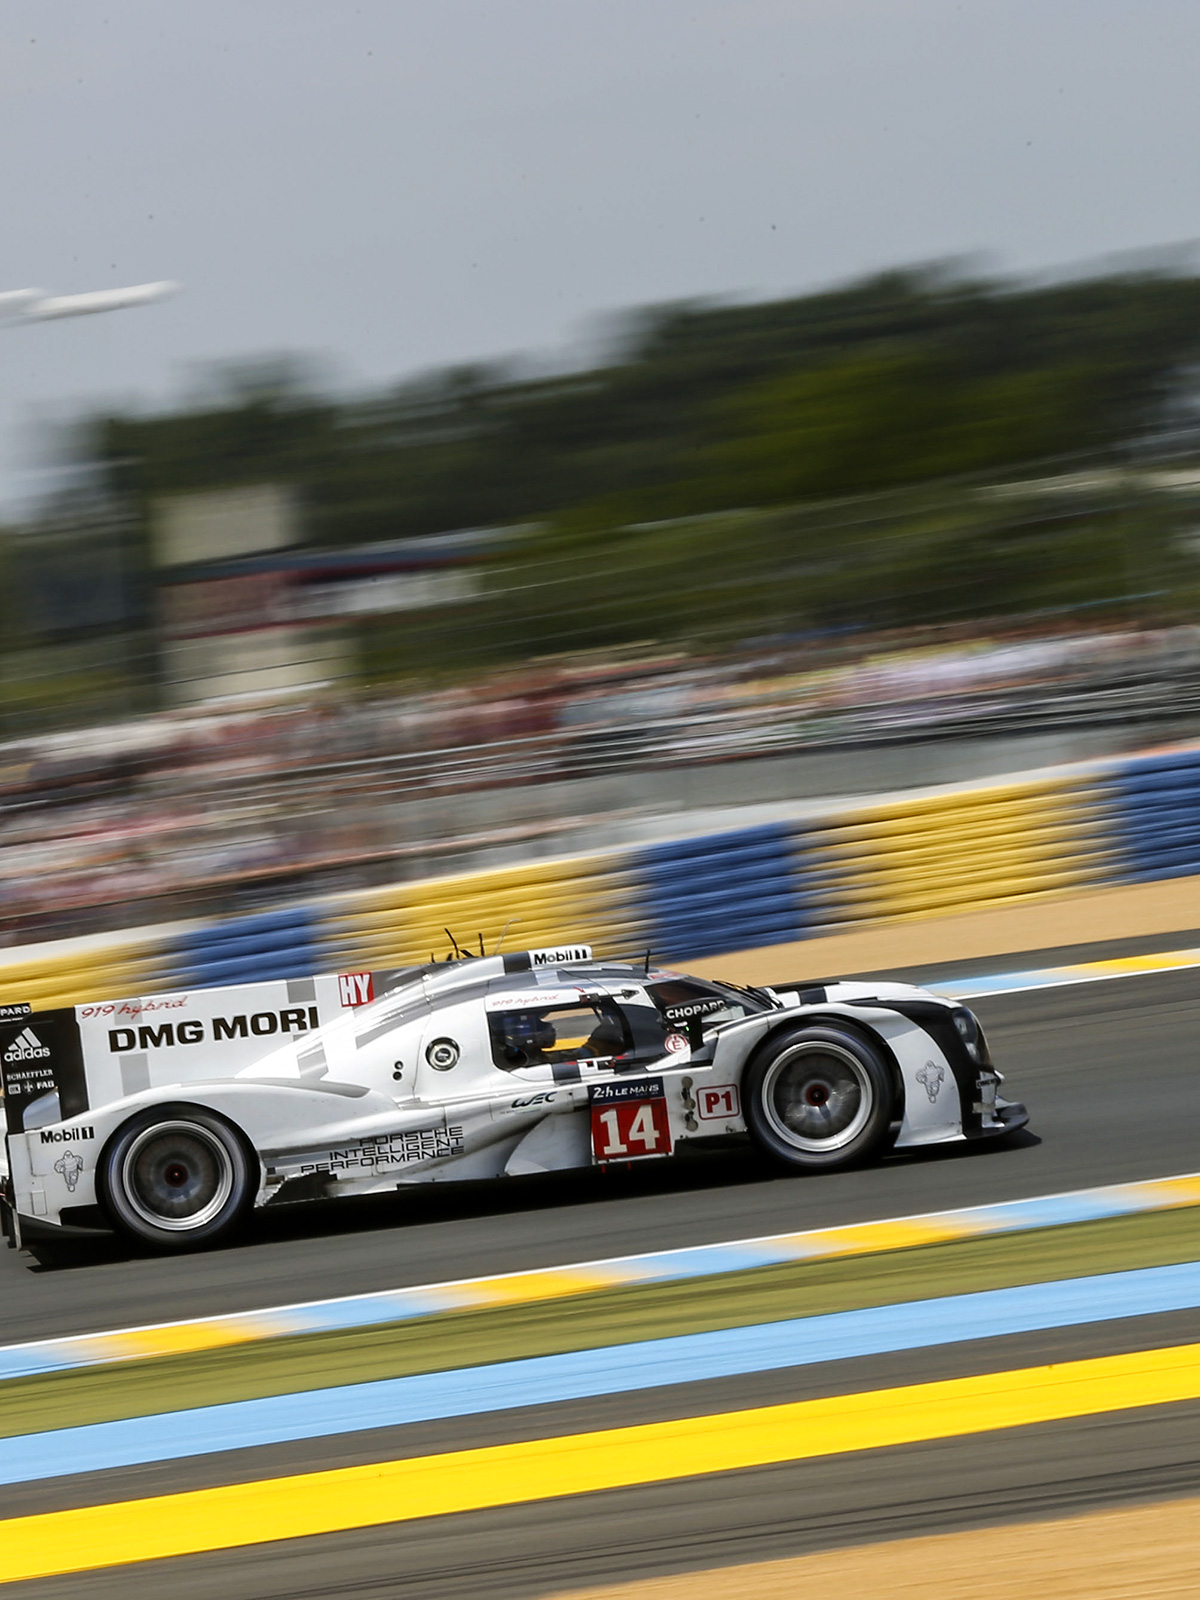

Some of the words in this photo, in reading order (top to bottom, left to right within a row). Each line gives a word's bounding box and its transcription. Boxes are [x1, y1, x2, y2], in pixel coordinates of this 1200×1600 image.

[534, 949, 572, 965] Mobil
[340, 974, 371, 1006] HY
[81, 1004, 115, 1019] 919
[118, 995, 188, 1019] hybrid
[666, 1000, 725, 1019] CHOPARD
[108, 1019, 204, 1053] DMG
[212, 1006, 320, 1041] MORI
[4, 1046, 51, 1062] adidas
[511, 1091, 558, 1108] WEC
[615, 1088, 628, 1096] LE
[629, 1084, 660, 1094] MANS
[705, 1091, 732, 1113] P1
[40, 1128, 80, 1144] Mobil
[359, 1126, 464, 1147] PORSCHE
[600, 1105, 660, 1155] 14
[330, 1136, 464, 1161] INTELLIGENT
[301, 1145, 465, 1174] PERFORMANCE
